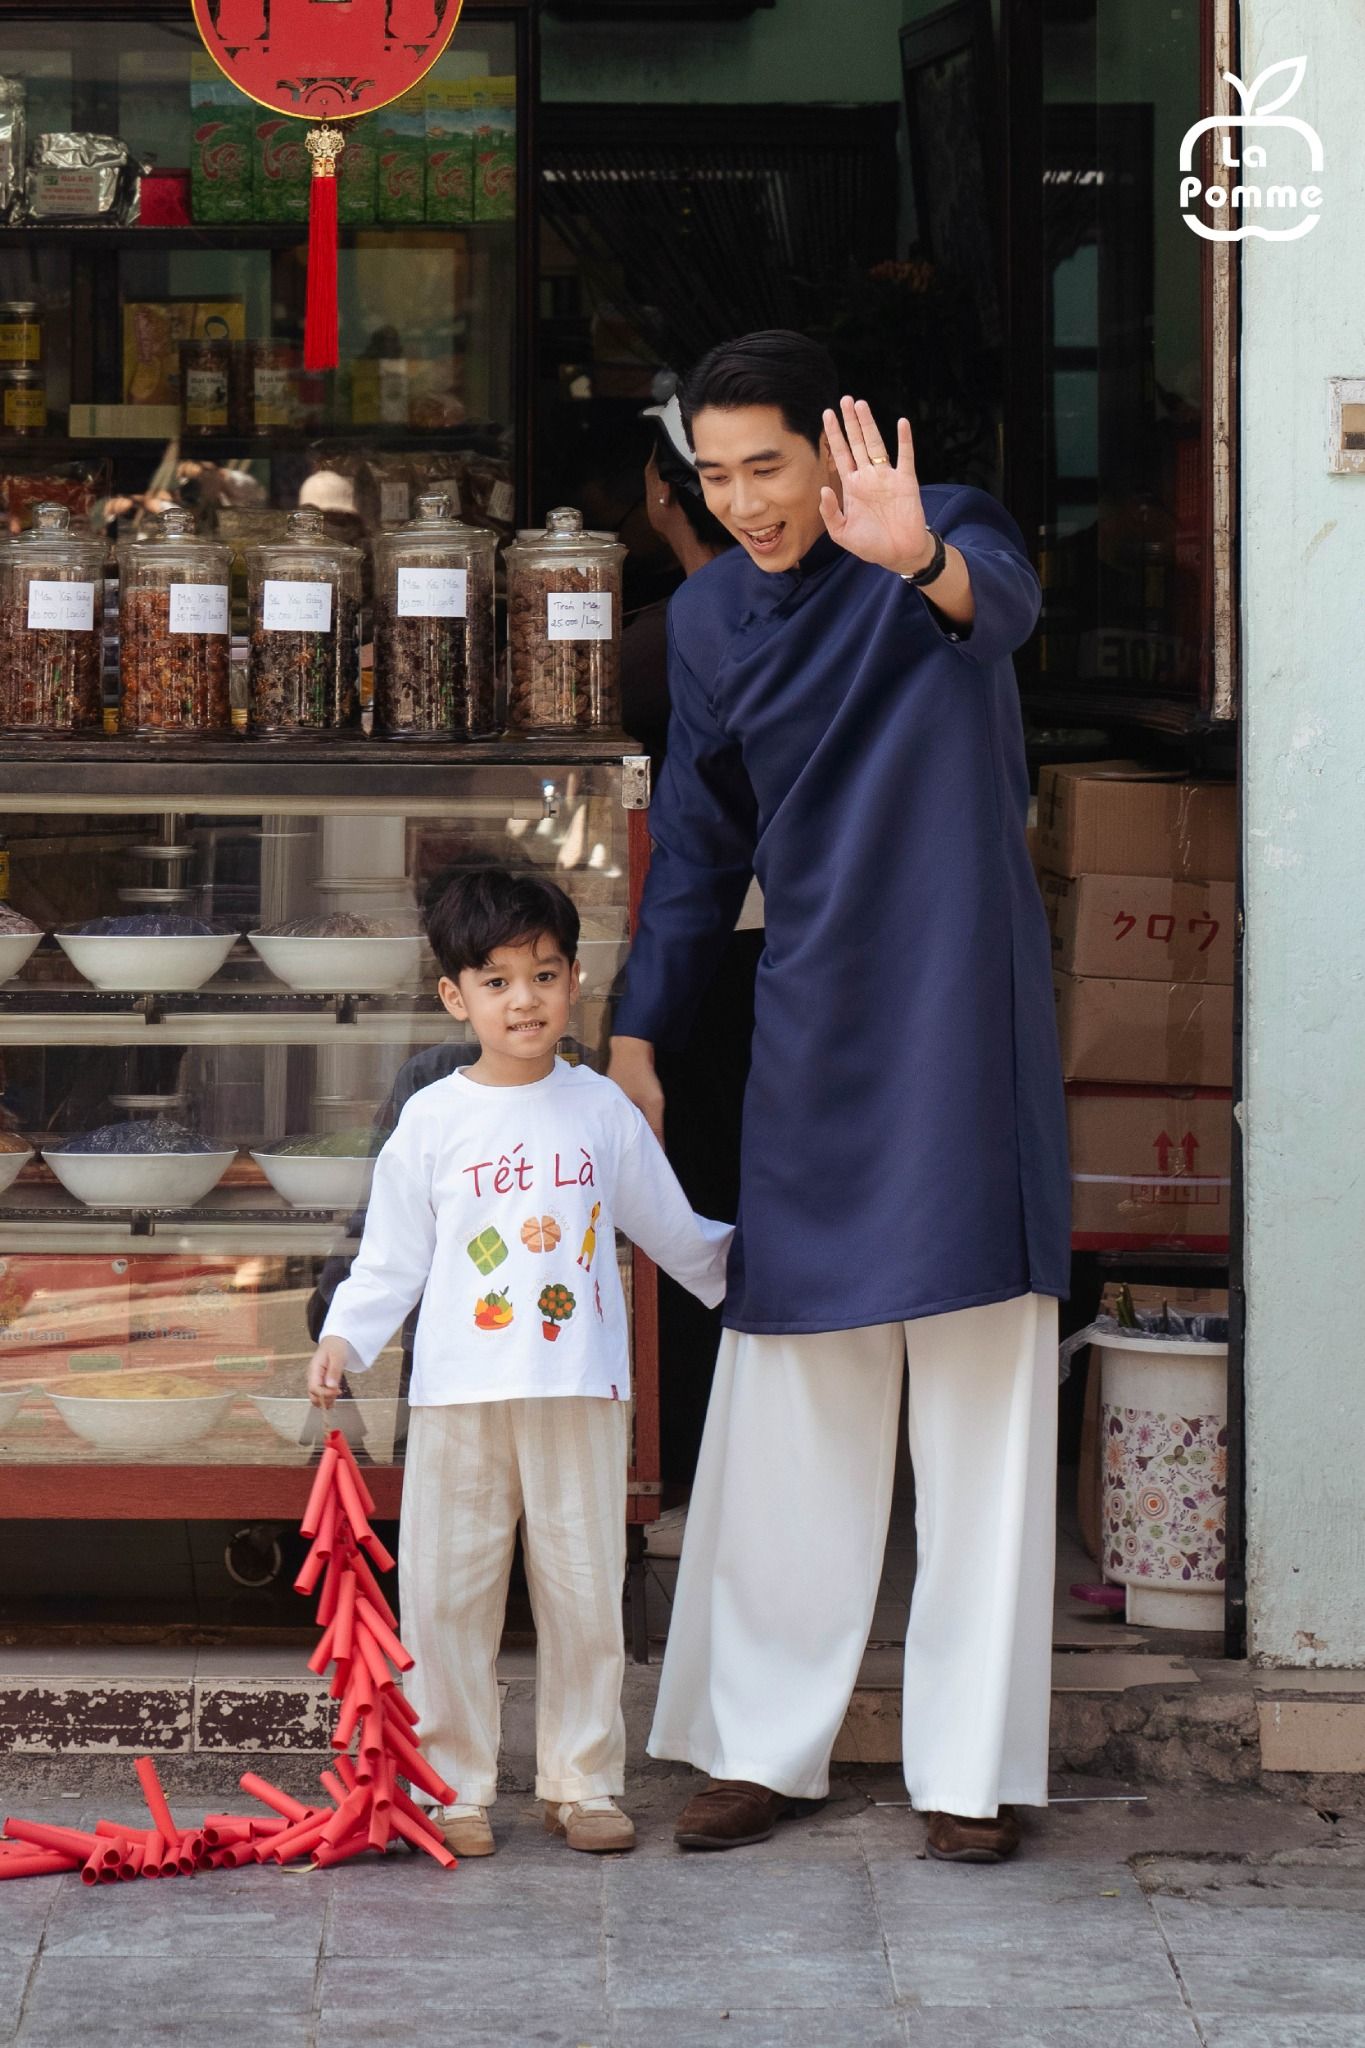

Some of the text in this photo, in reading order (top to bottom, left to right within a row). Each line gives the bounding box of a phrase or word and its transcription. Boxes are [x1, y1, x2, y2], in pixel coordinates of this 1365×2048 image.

[1113, 911, 1219, 952] クロウ
[462, 1142, 594, 1197] Tết Là
